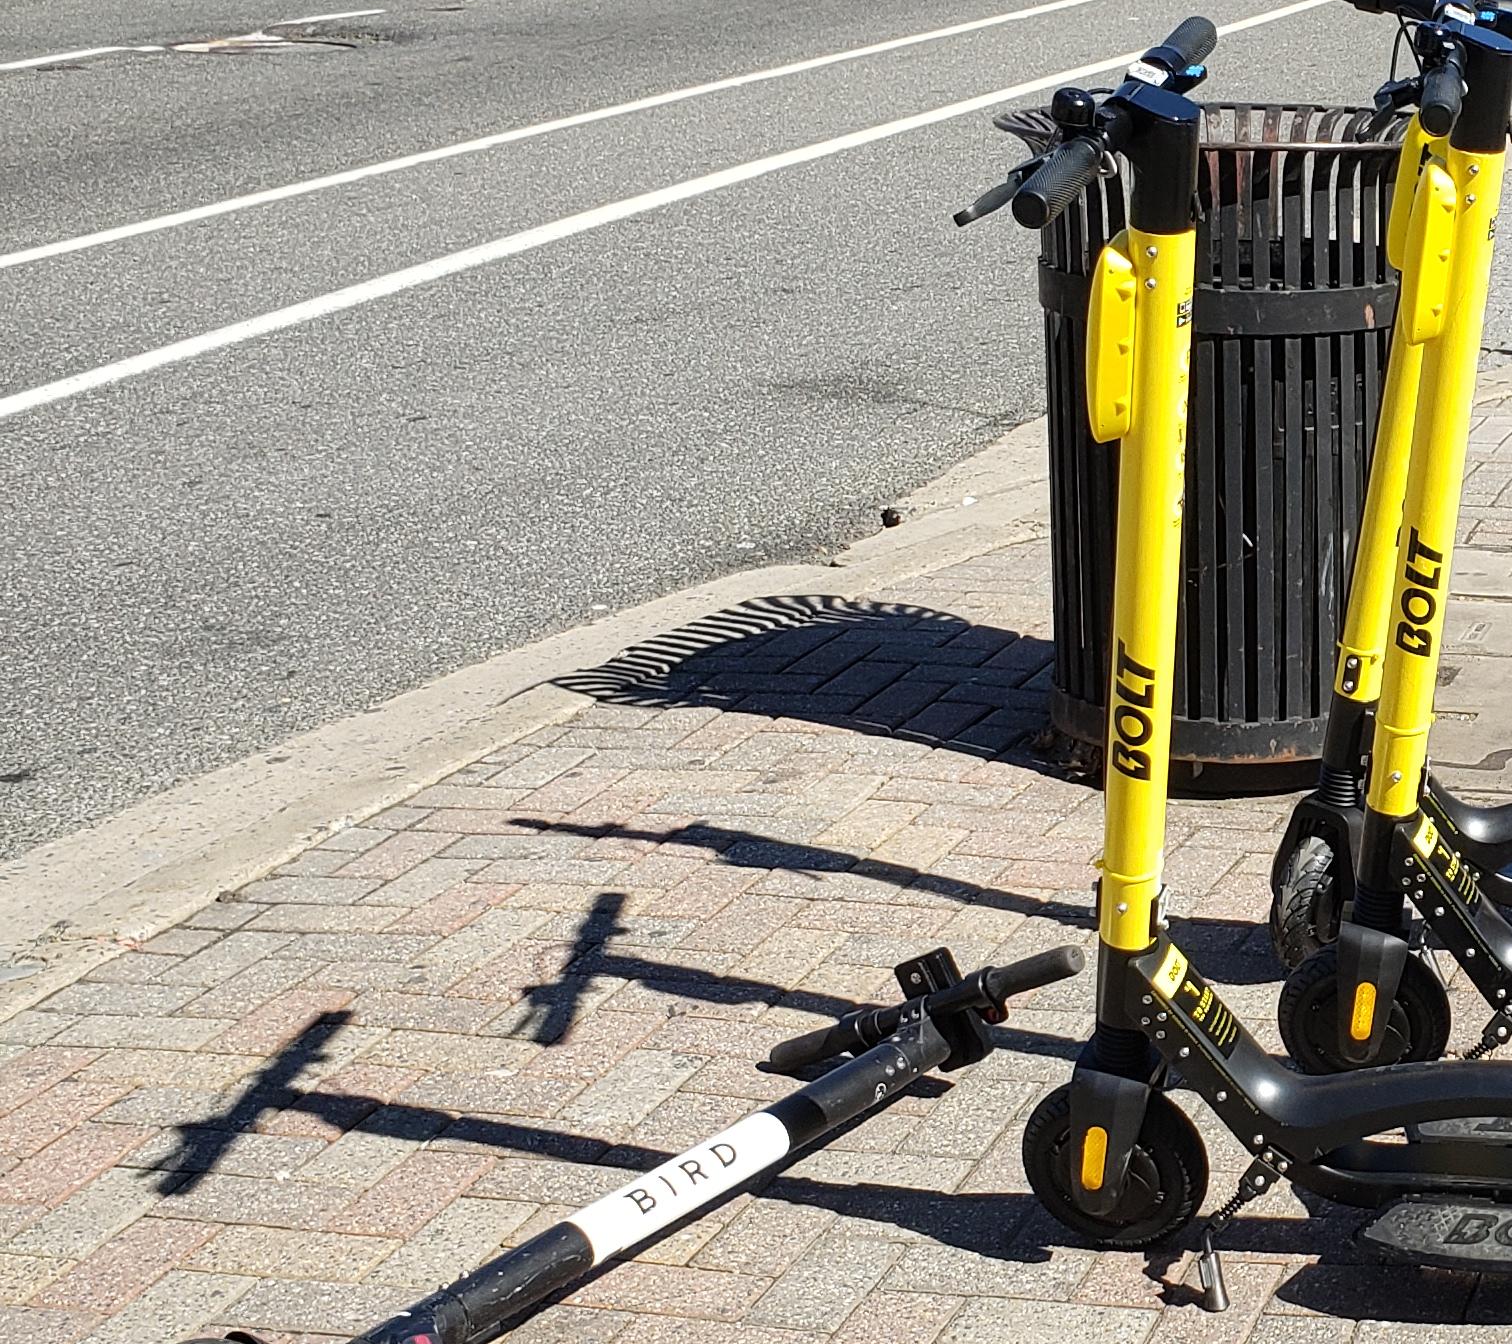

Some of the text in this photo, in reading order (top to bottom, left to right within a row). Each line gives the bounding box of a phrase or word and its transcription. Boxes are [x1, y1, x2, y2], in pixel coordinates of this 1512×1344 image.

[1395, 525, 1443, 657] BOLT
[1112, 637, 1155, 781] BOLT
[623, 1143, 737, 1215] BIRD
